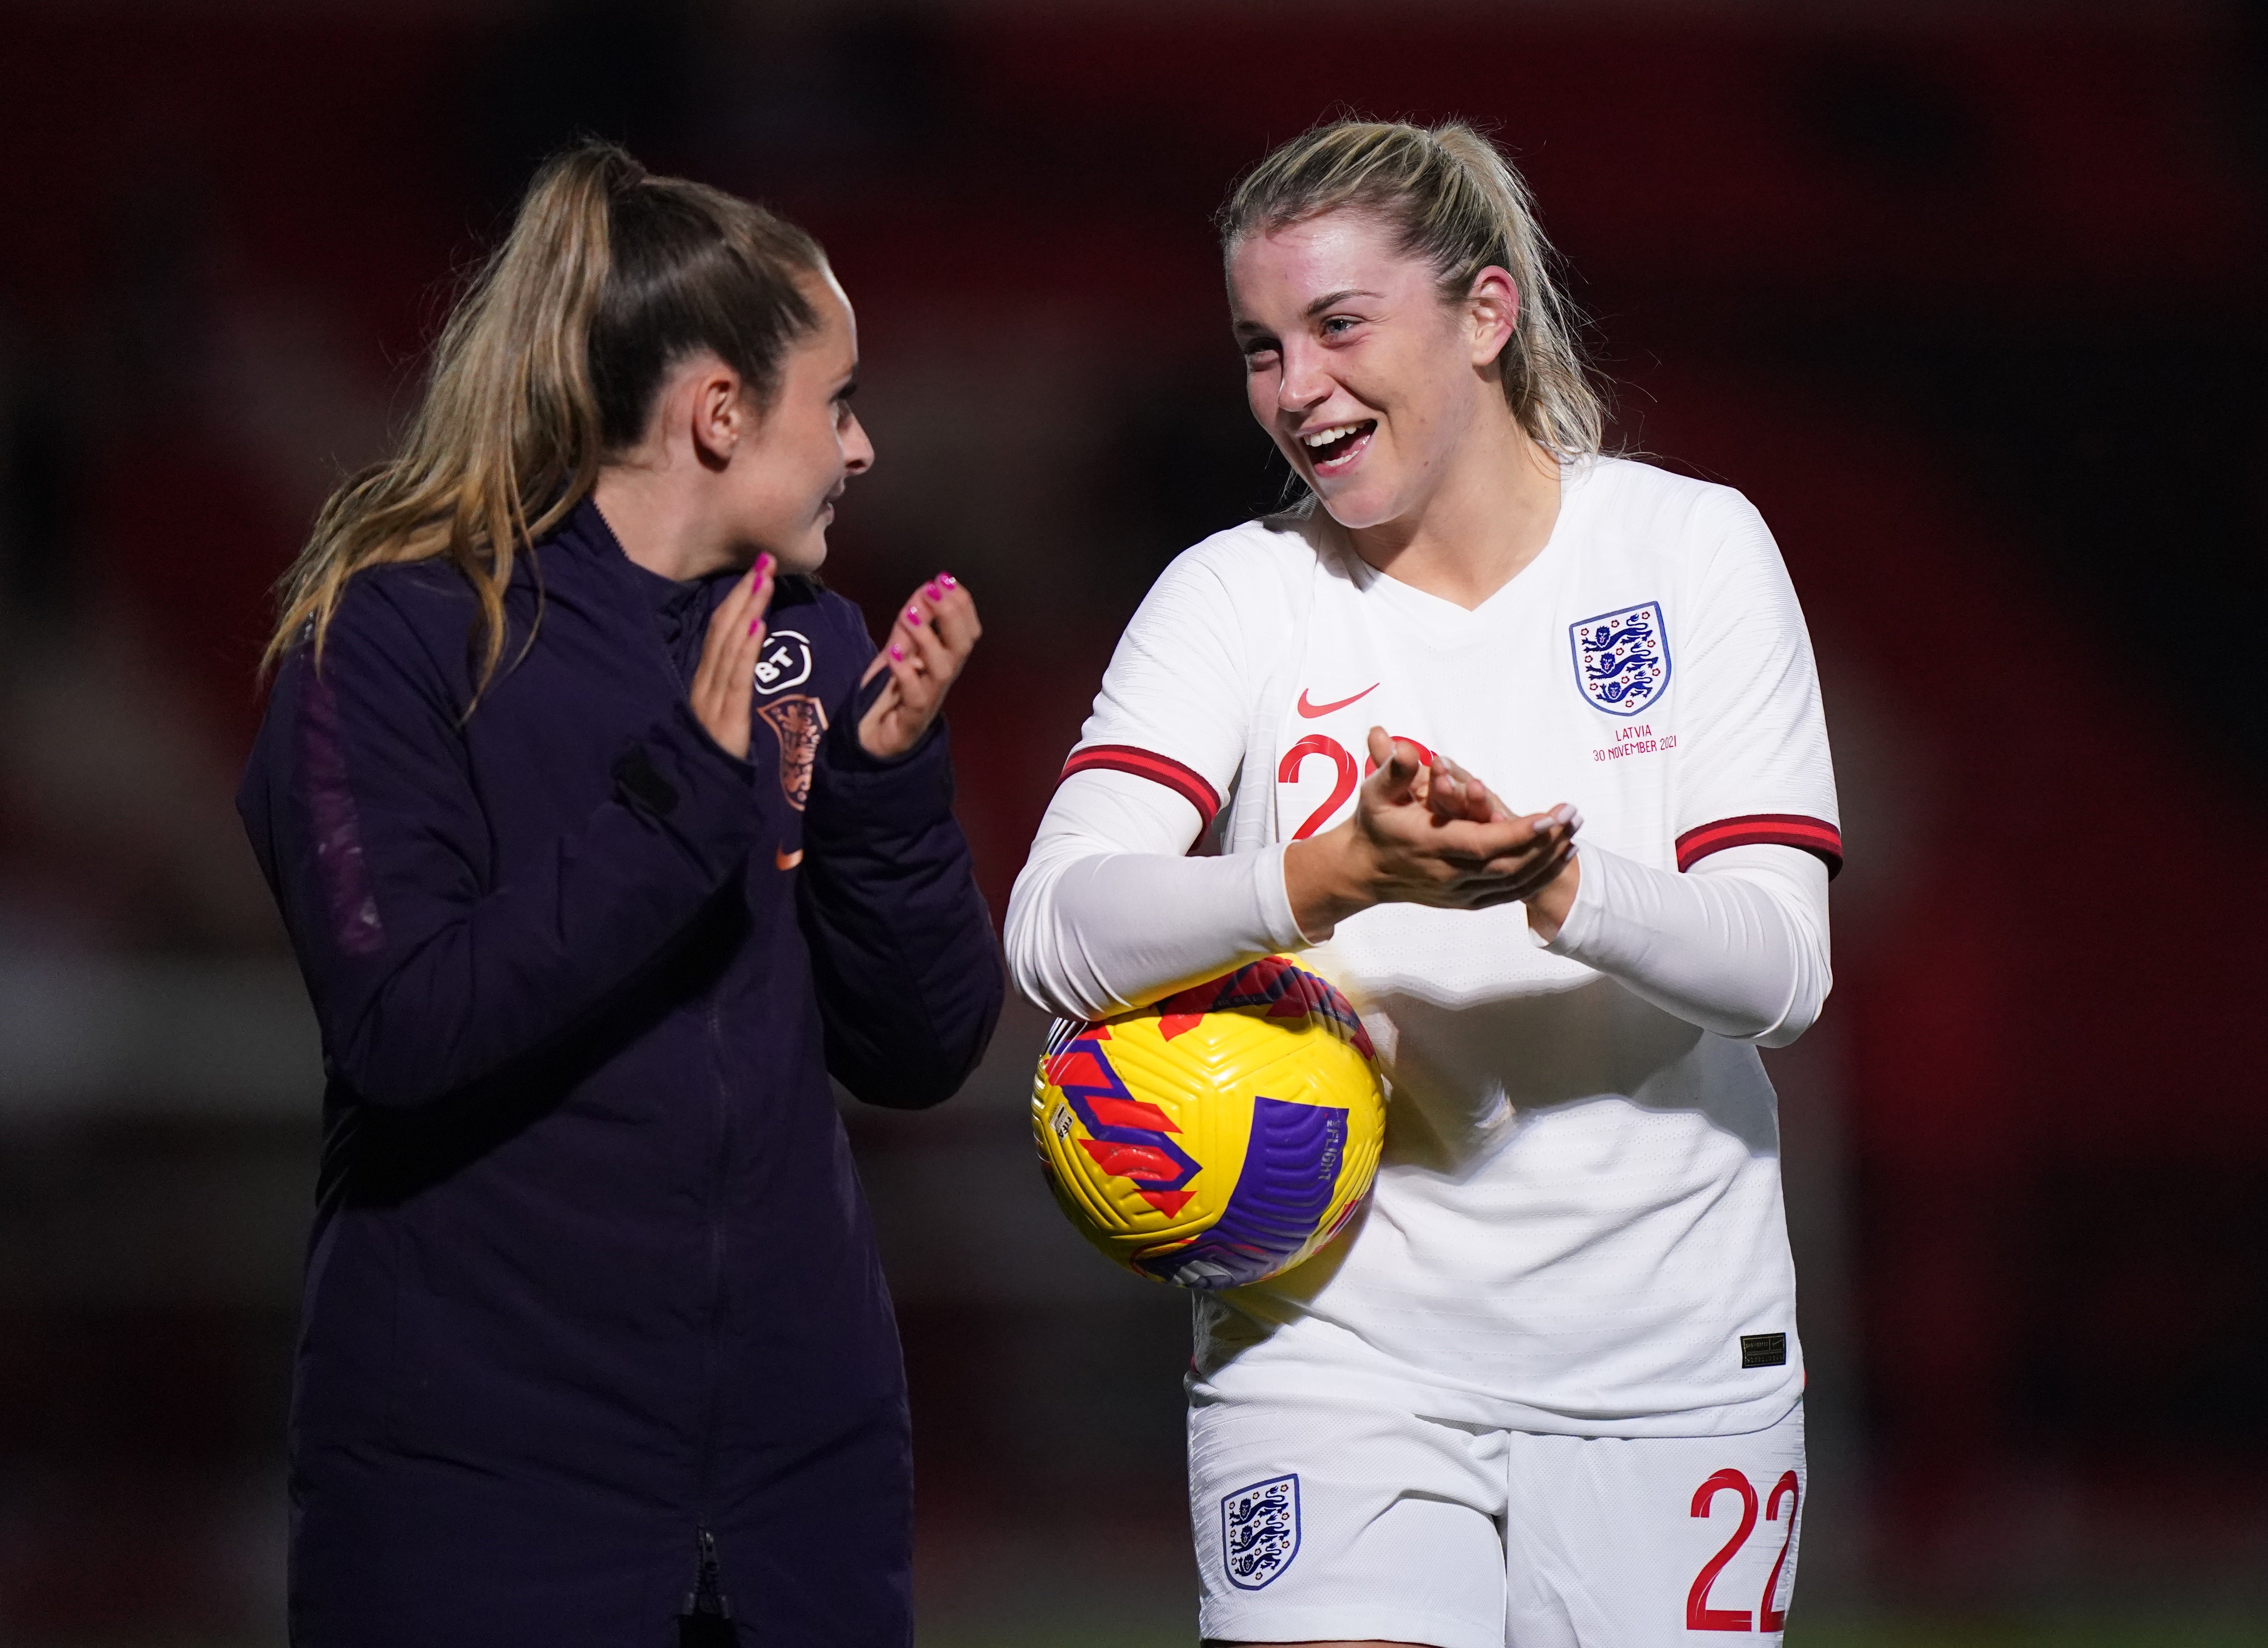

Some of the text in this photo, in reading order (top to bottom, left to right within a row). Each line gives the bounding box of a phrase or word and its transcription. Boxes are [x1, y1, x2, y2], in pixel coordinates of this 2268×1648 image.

[755, 646, 793, 684] BT
[1593, 735, 1677, 761] 30 NOVEMBER 2021
[1615, 724, 1652, 741] LATVIA
[1058, 1116, 1072, 1138] FIFA
[1318, 1128, 1339, 1180] FLIGHT
[1687, 1468, 1799, 1632] 22
